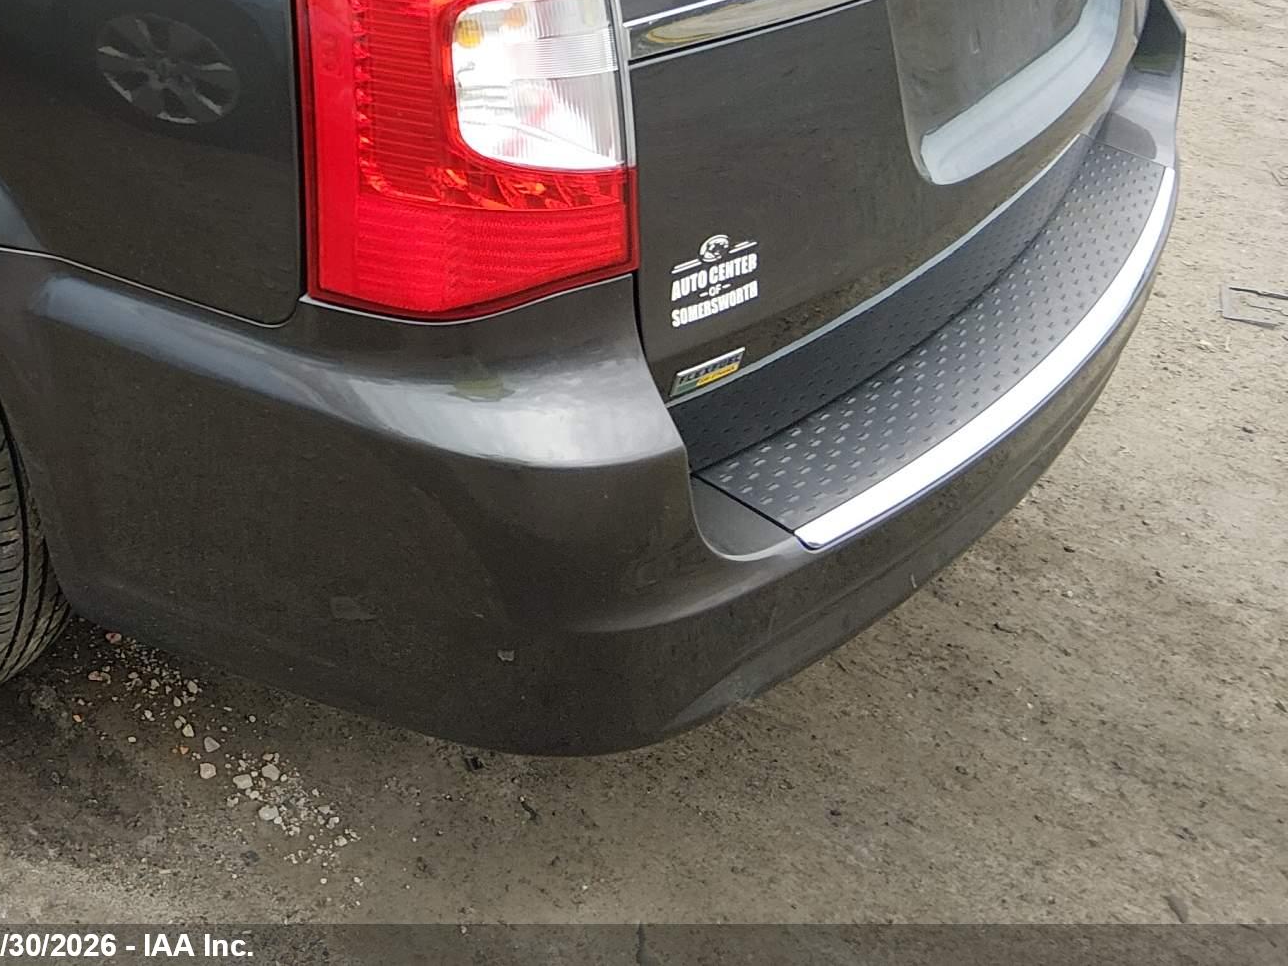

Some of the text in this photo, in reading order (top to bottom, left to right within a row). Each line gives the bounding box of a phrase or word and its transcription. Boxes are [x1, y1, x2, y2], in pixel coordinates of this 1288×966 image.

[671, 252, 758, 302] AUTO CENTER
[671, 280, 759, 327] SOMERSWORTH
